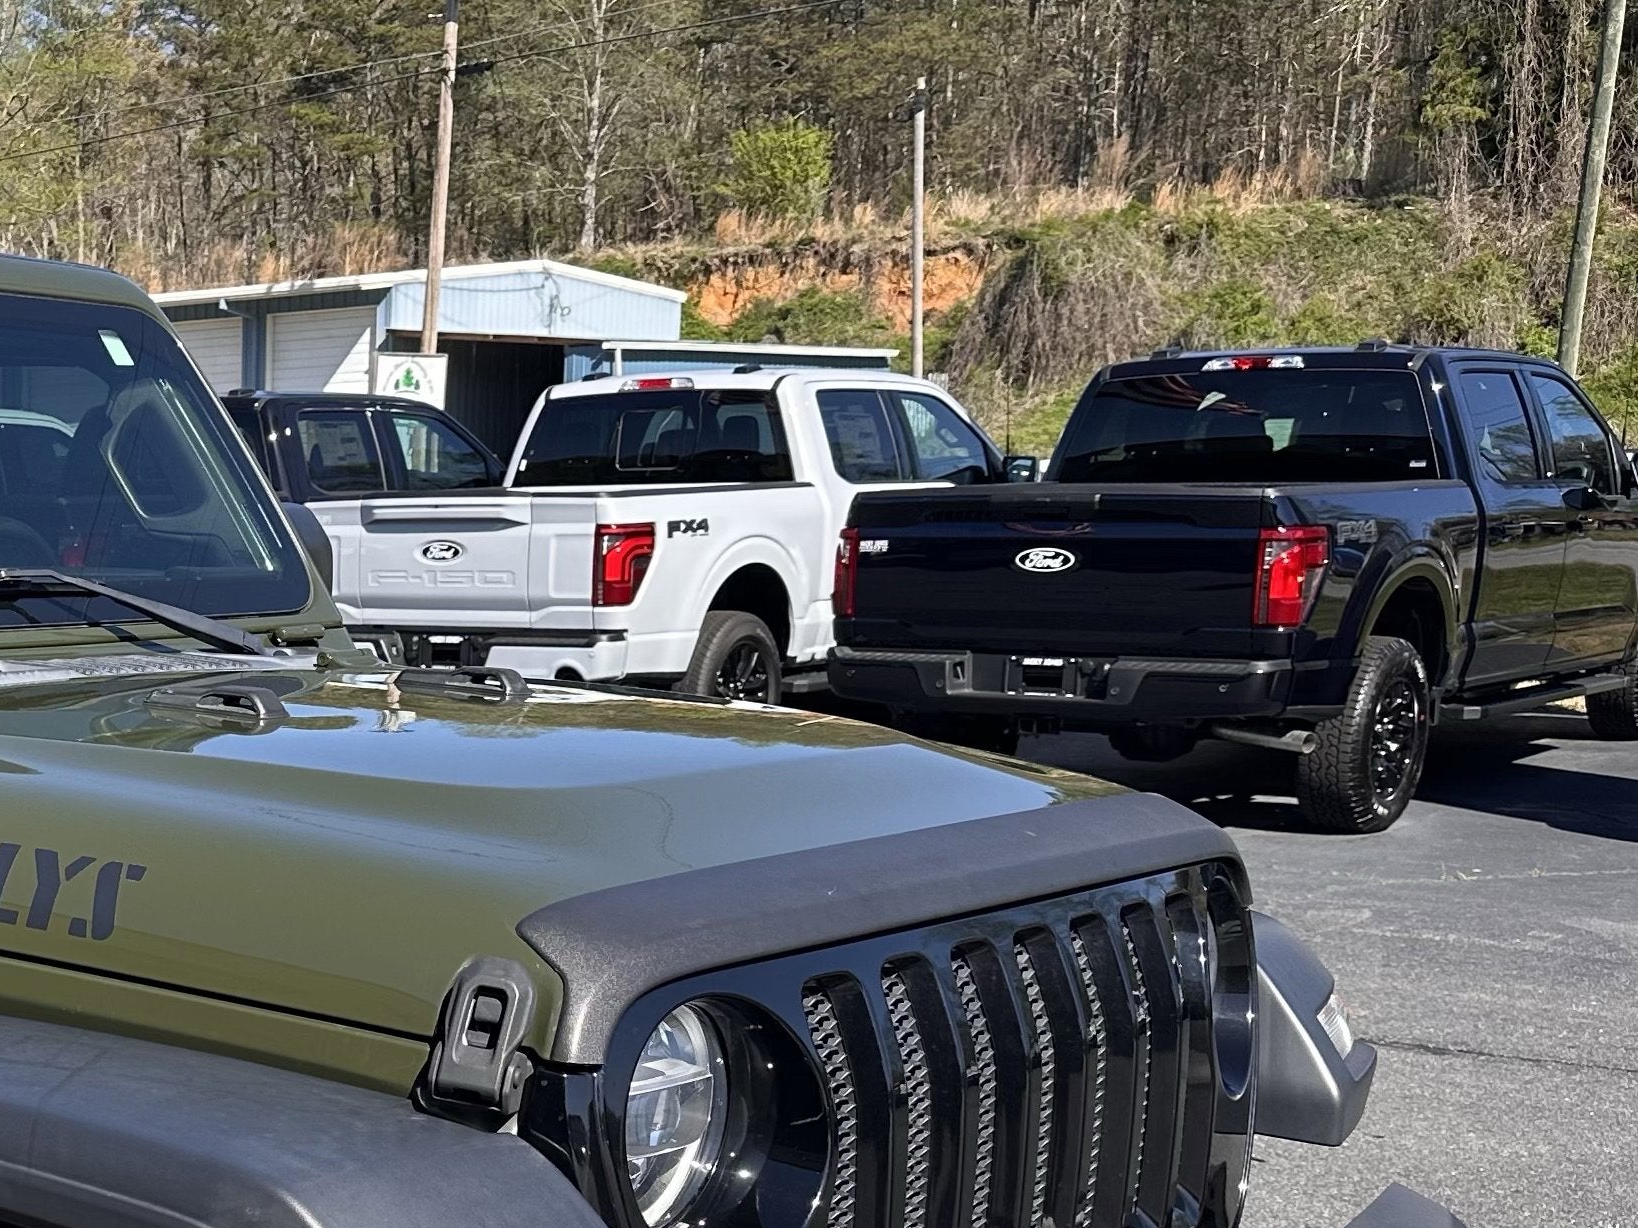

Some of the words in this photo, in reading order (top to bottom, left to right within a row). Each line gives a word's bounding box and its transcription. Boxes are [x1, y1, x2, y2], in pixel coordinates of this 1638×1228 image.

[666, 517, 709, 539] FX4
[1336, 518, 1379, 546] FX4
[424, 542, 456, 561] Ford
[1022, 550, 1066, 569] Ford
[367, 569, 516, 588] F-150
